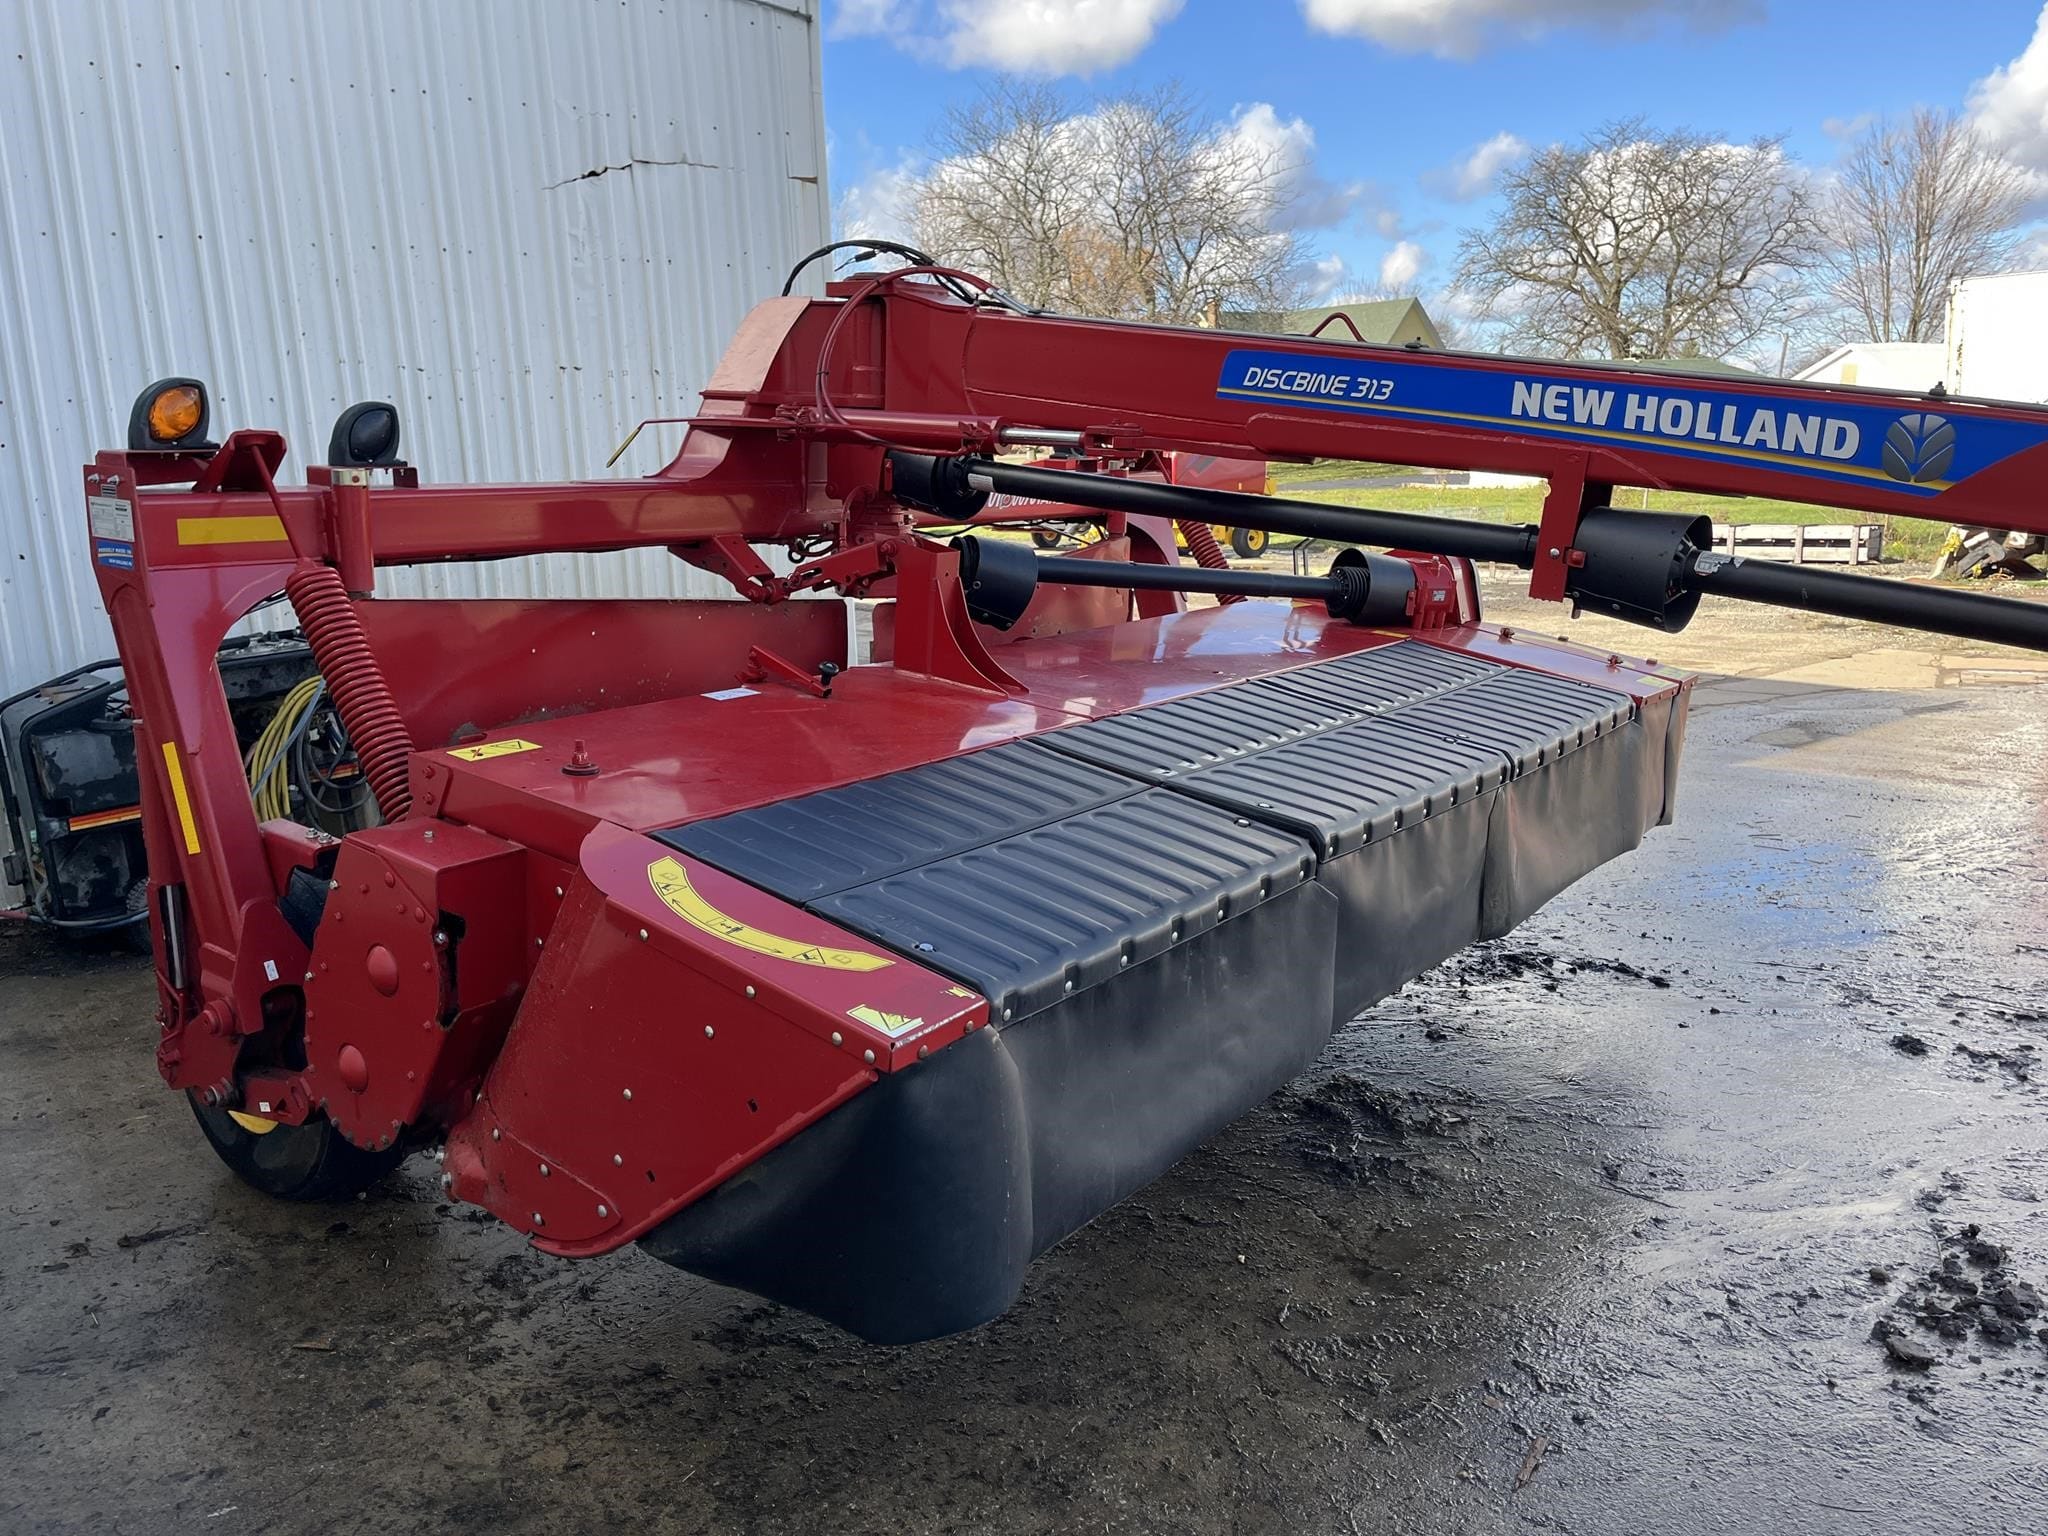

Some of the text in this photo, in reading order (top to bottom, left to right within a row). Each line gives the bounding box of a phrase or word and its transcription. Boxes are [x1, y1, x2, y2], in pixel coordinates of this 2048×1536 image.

[1243, 367, 1394, 400] DISCBINE 313
[1511, 381, 1860, 460] NEW HOLLAND
